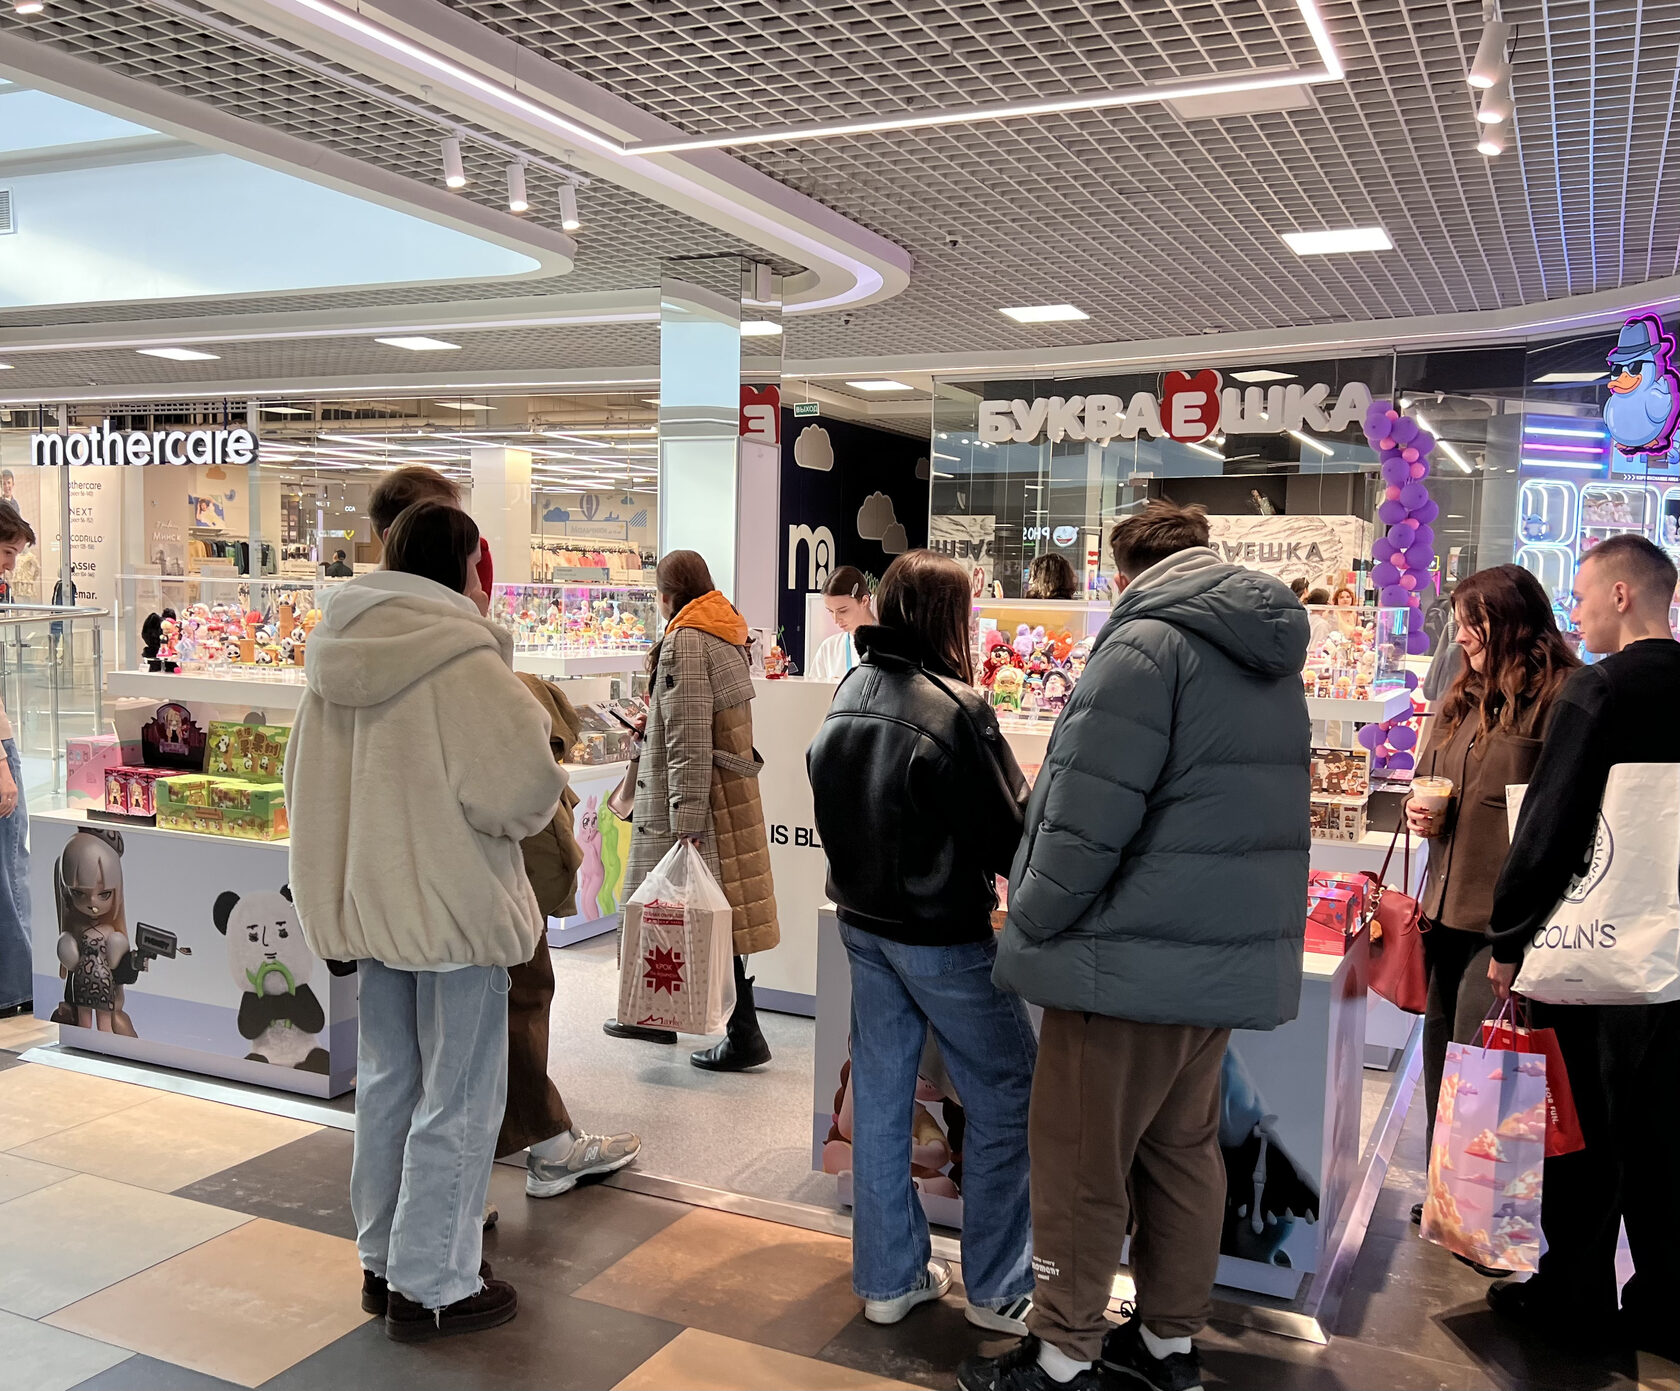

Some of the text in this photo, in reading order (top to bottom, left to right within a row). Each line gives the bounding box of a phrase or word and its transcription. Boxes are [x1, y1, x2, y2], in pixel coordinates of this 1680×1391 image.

[31, 419, 257, 466] mothercare
[770, 824, 824, 849] IS BL
[1532, 919, 1617, 949] COLIN'S
